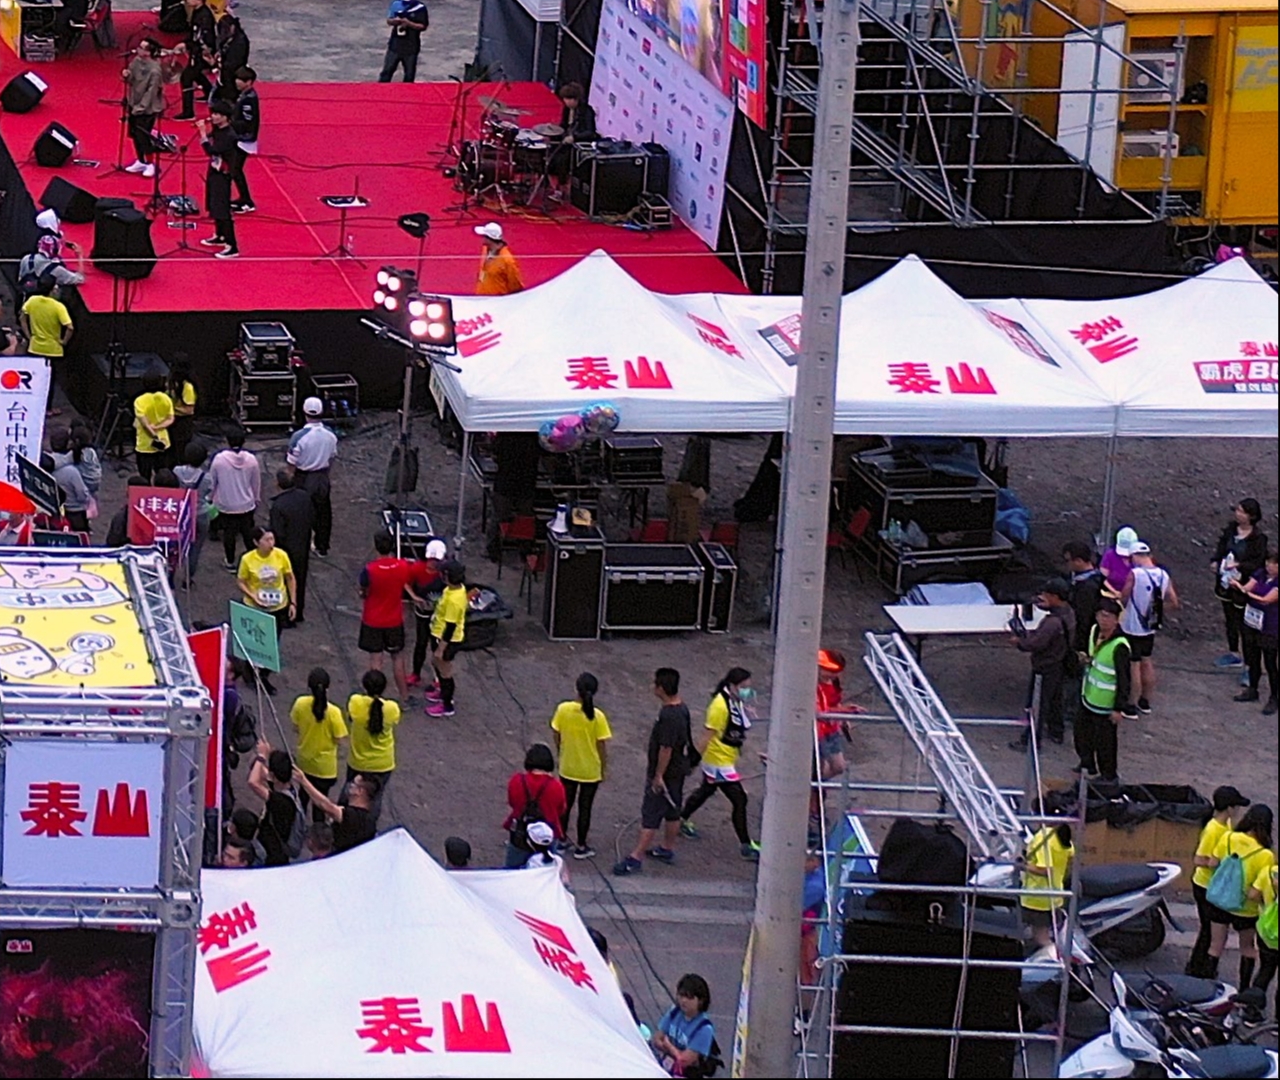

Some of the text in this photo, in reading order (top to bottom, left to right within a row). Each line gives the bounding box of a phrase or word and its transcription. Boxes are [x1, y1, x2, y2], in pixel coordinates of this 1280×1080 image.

[564, 355, 674, 391] 泰山
[886, 360, 998, 395] 泰山
[1199, 362, 1245, 382] 霸虎
[19, 781, 150, 839] 泰山
[196, 900, 272, 994] 泰山
[513, 908, 600, 996] 泰山
[354, 993, 513, 1055] 泰山
